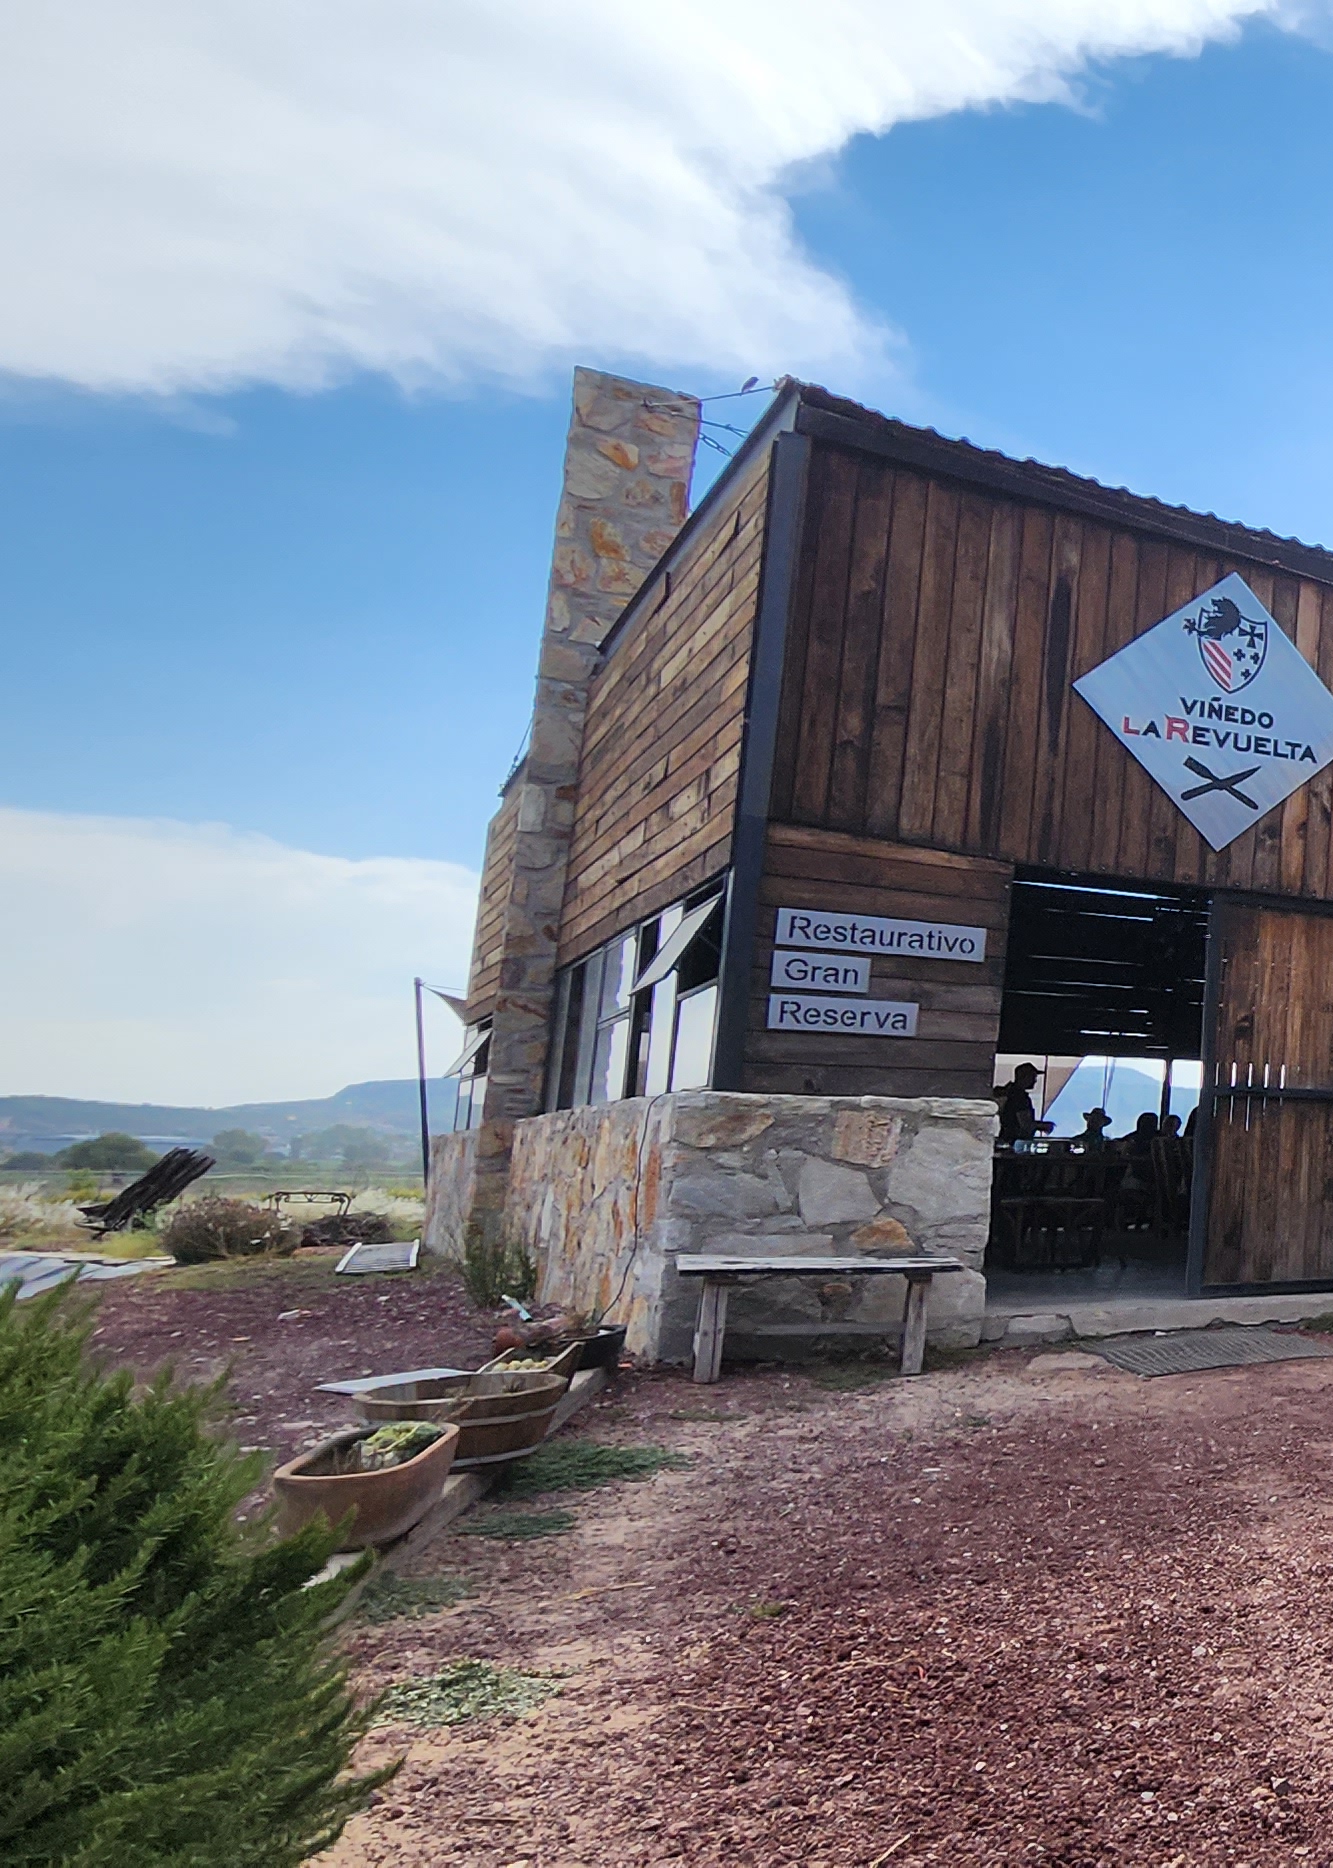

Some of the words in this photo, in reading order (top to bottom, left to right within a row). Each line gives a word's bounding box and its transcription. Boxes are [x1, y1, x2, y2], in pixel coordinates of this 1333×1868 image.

[1179, 696, 1274, 729] VIÑEDO
[788, 914, 976, 954] Restaurativo
[784, 958, 859, 985] Gran
[778, 1000, 908, 1031] Reserva
